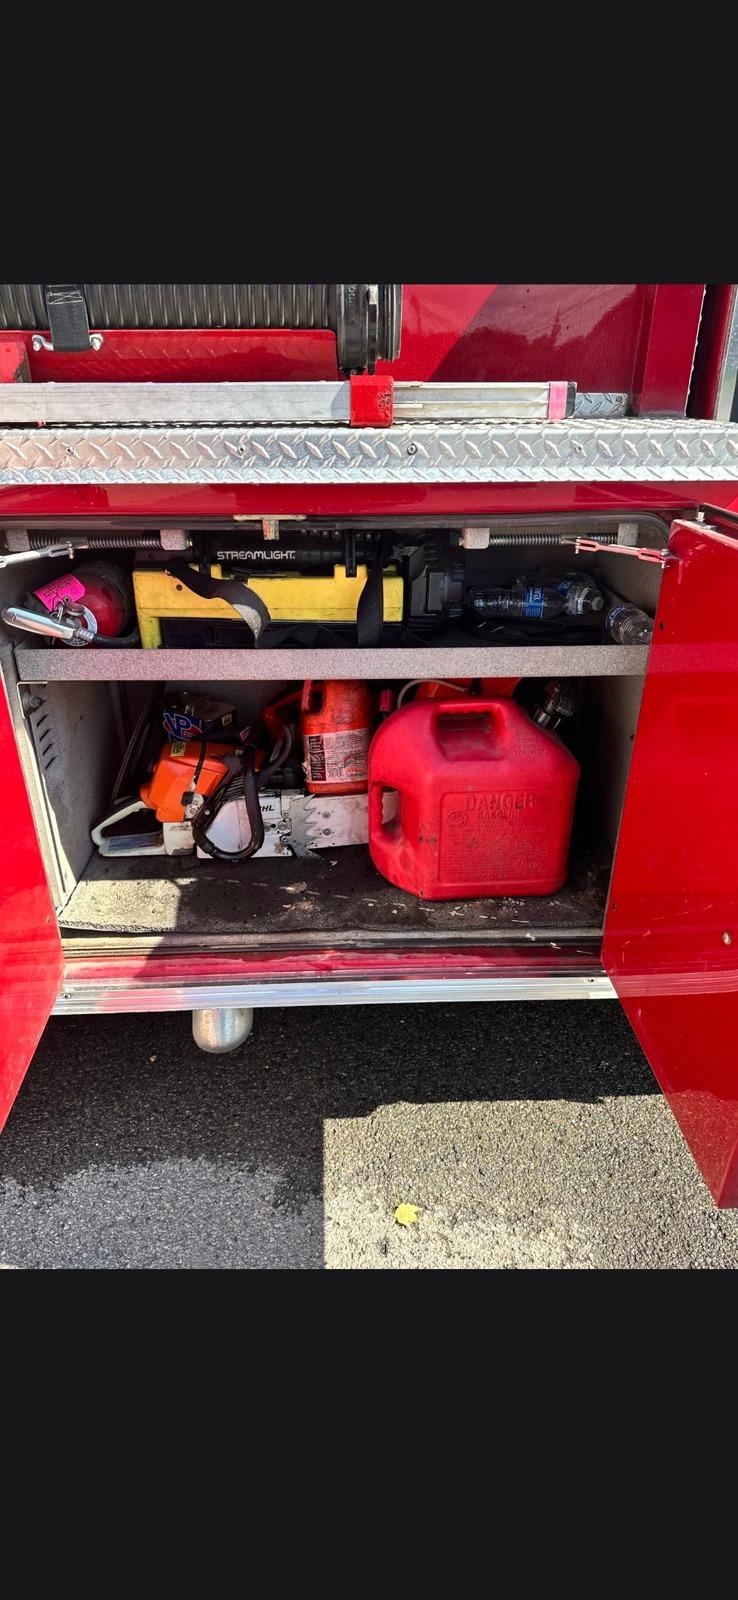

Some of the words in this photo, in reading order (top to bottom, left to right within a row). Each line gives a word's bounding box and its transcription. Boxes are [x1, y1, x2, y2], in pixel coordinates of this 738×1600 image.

[216, 550, 296, 560] STREAMLIGHT
[162, 712, 192, 740] VP
[464, 792, 537, 811] DANGER
